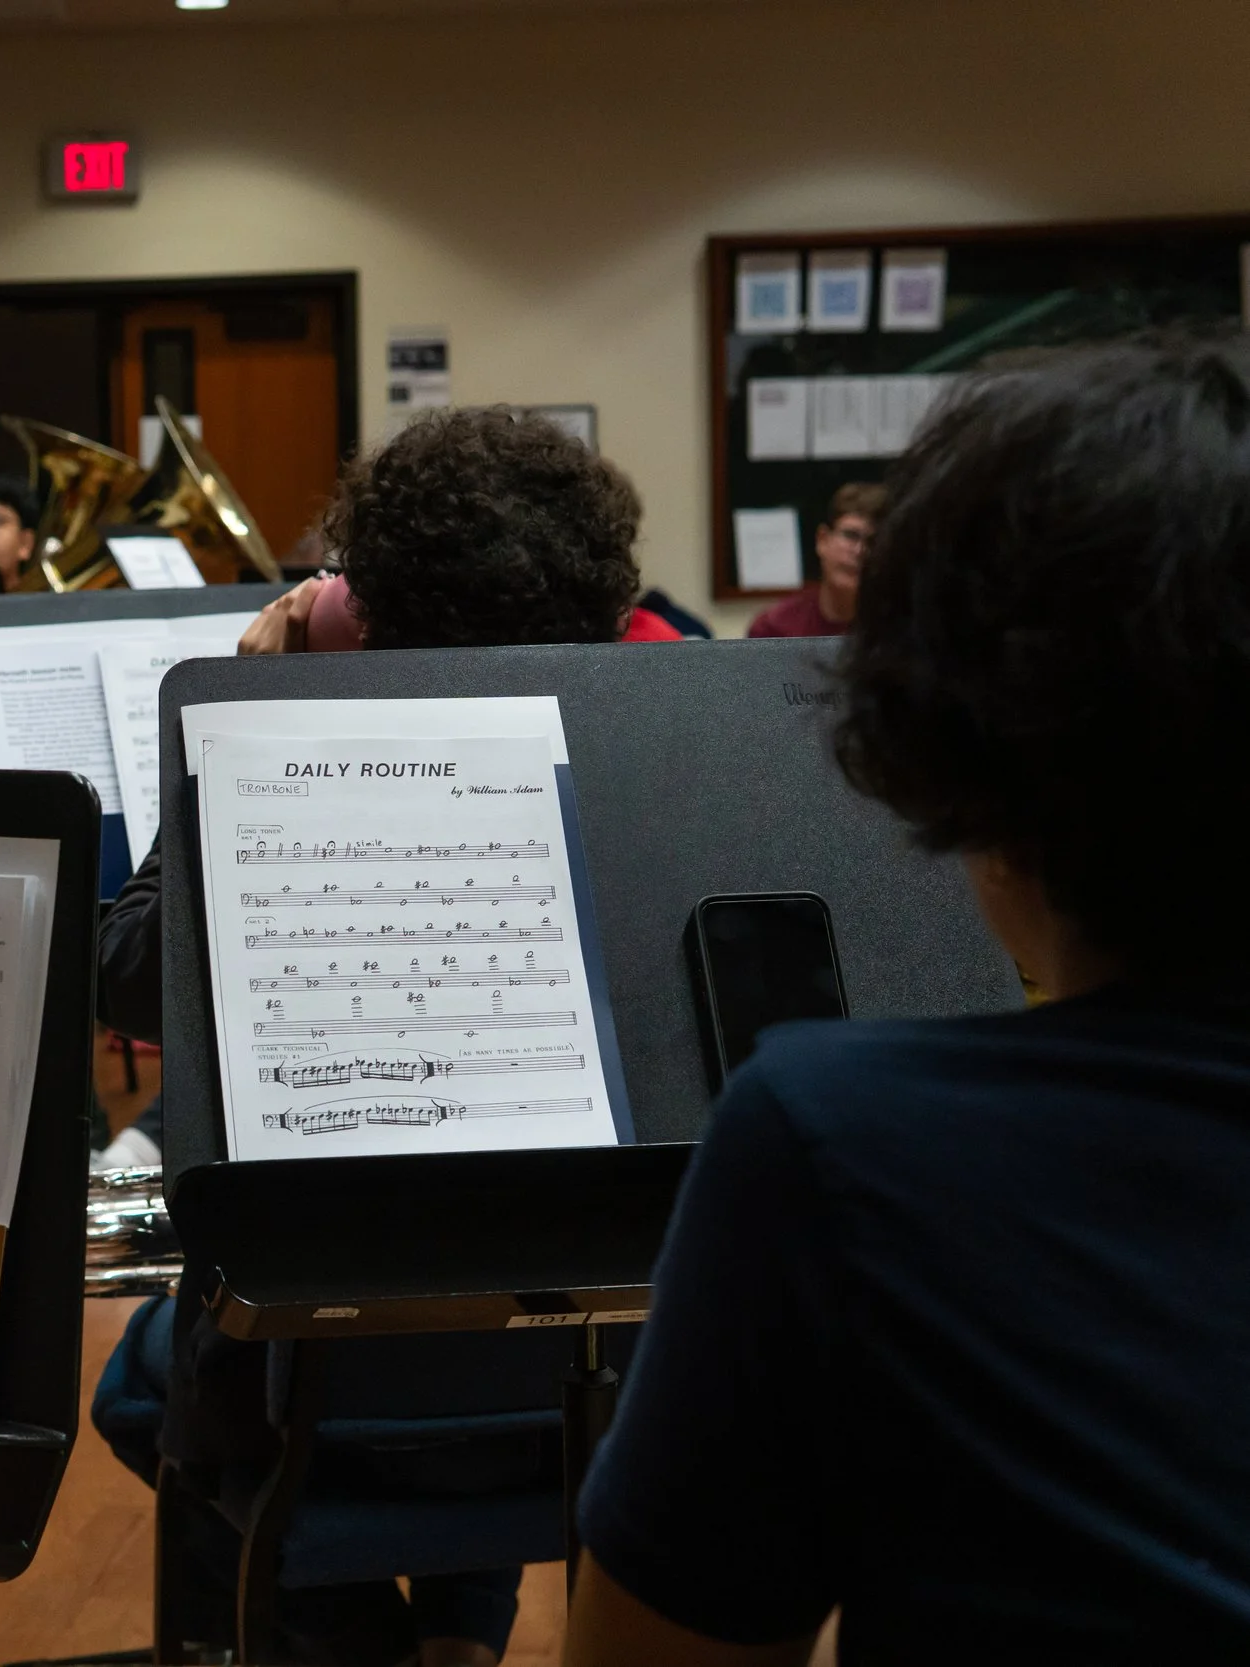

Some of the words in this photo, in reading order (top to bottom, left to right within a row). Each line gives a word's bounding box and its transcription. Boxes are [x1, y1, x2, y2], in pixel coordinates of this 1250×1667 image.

[284, 762, 351, 777] DAILY
[360, 762, 457, 777] ROUTINE
[239, 783, 301, 794] TROMBONE
[451, 785, 464, 798] by
[467, 785, 508, 796] William
[512, 785, 544, 795] Adam
[356, 839, 383, 847] simile
[527, 1315, 568, 1325] 101
